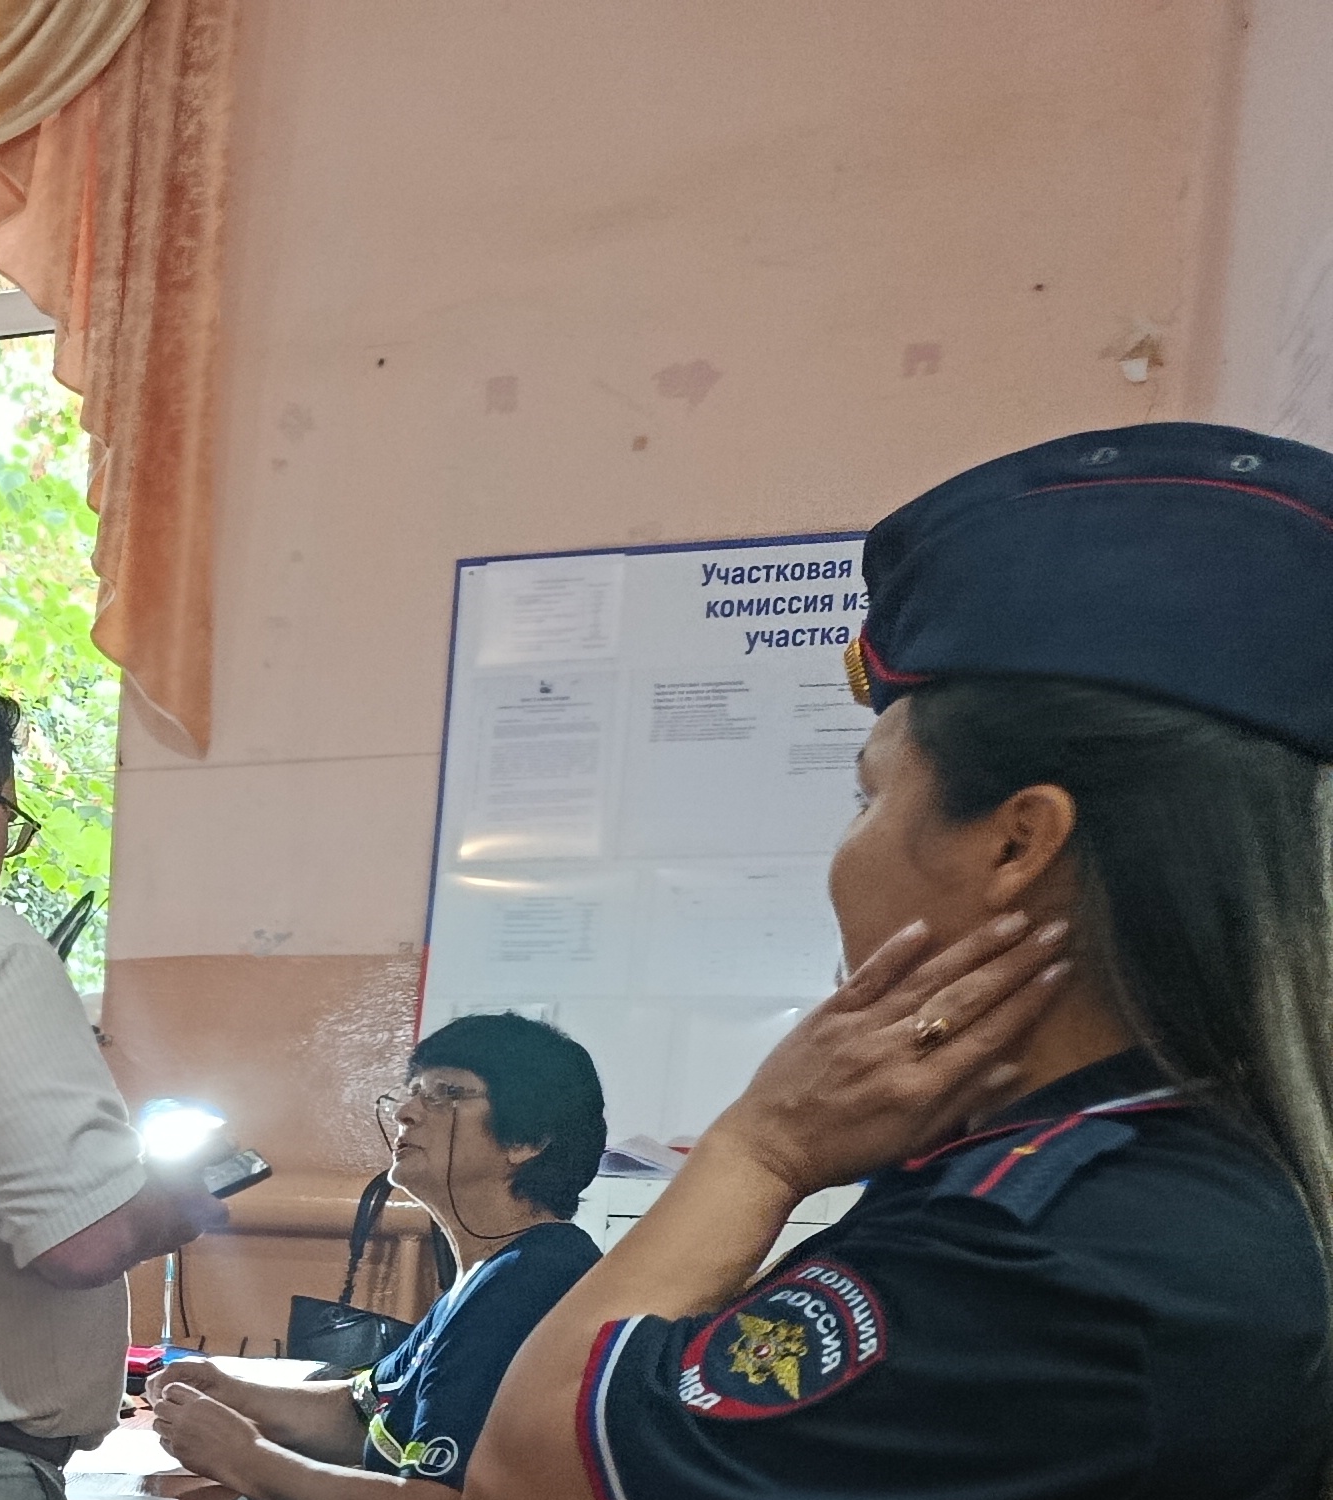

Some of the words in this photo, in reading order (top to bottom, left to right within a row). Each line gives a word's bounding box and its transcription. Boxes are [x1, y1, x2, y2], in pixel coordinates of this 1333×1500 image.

[701, 559, 853, 587] Участковая
[705, 594, 834, 619] комиссия
[744, 626, 850, 655] участка
[769, 1290, 842, 1375] РОССИЯ
[796, 1266, 878, 1362] ПОЛИЦИЯ
[678, 1365, 722, 1410] МВД
